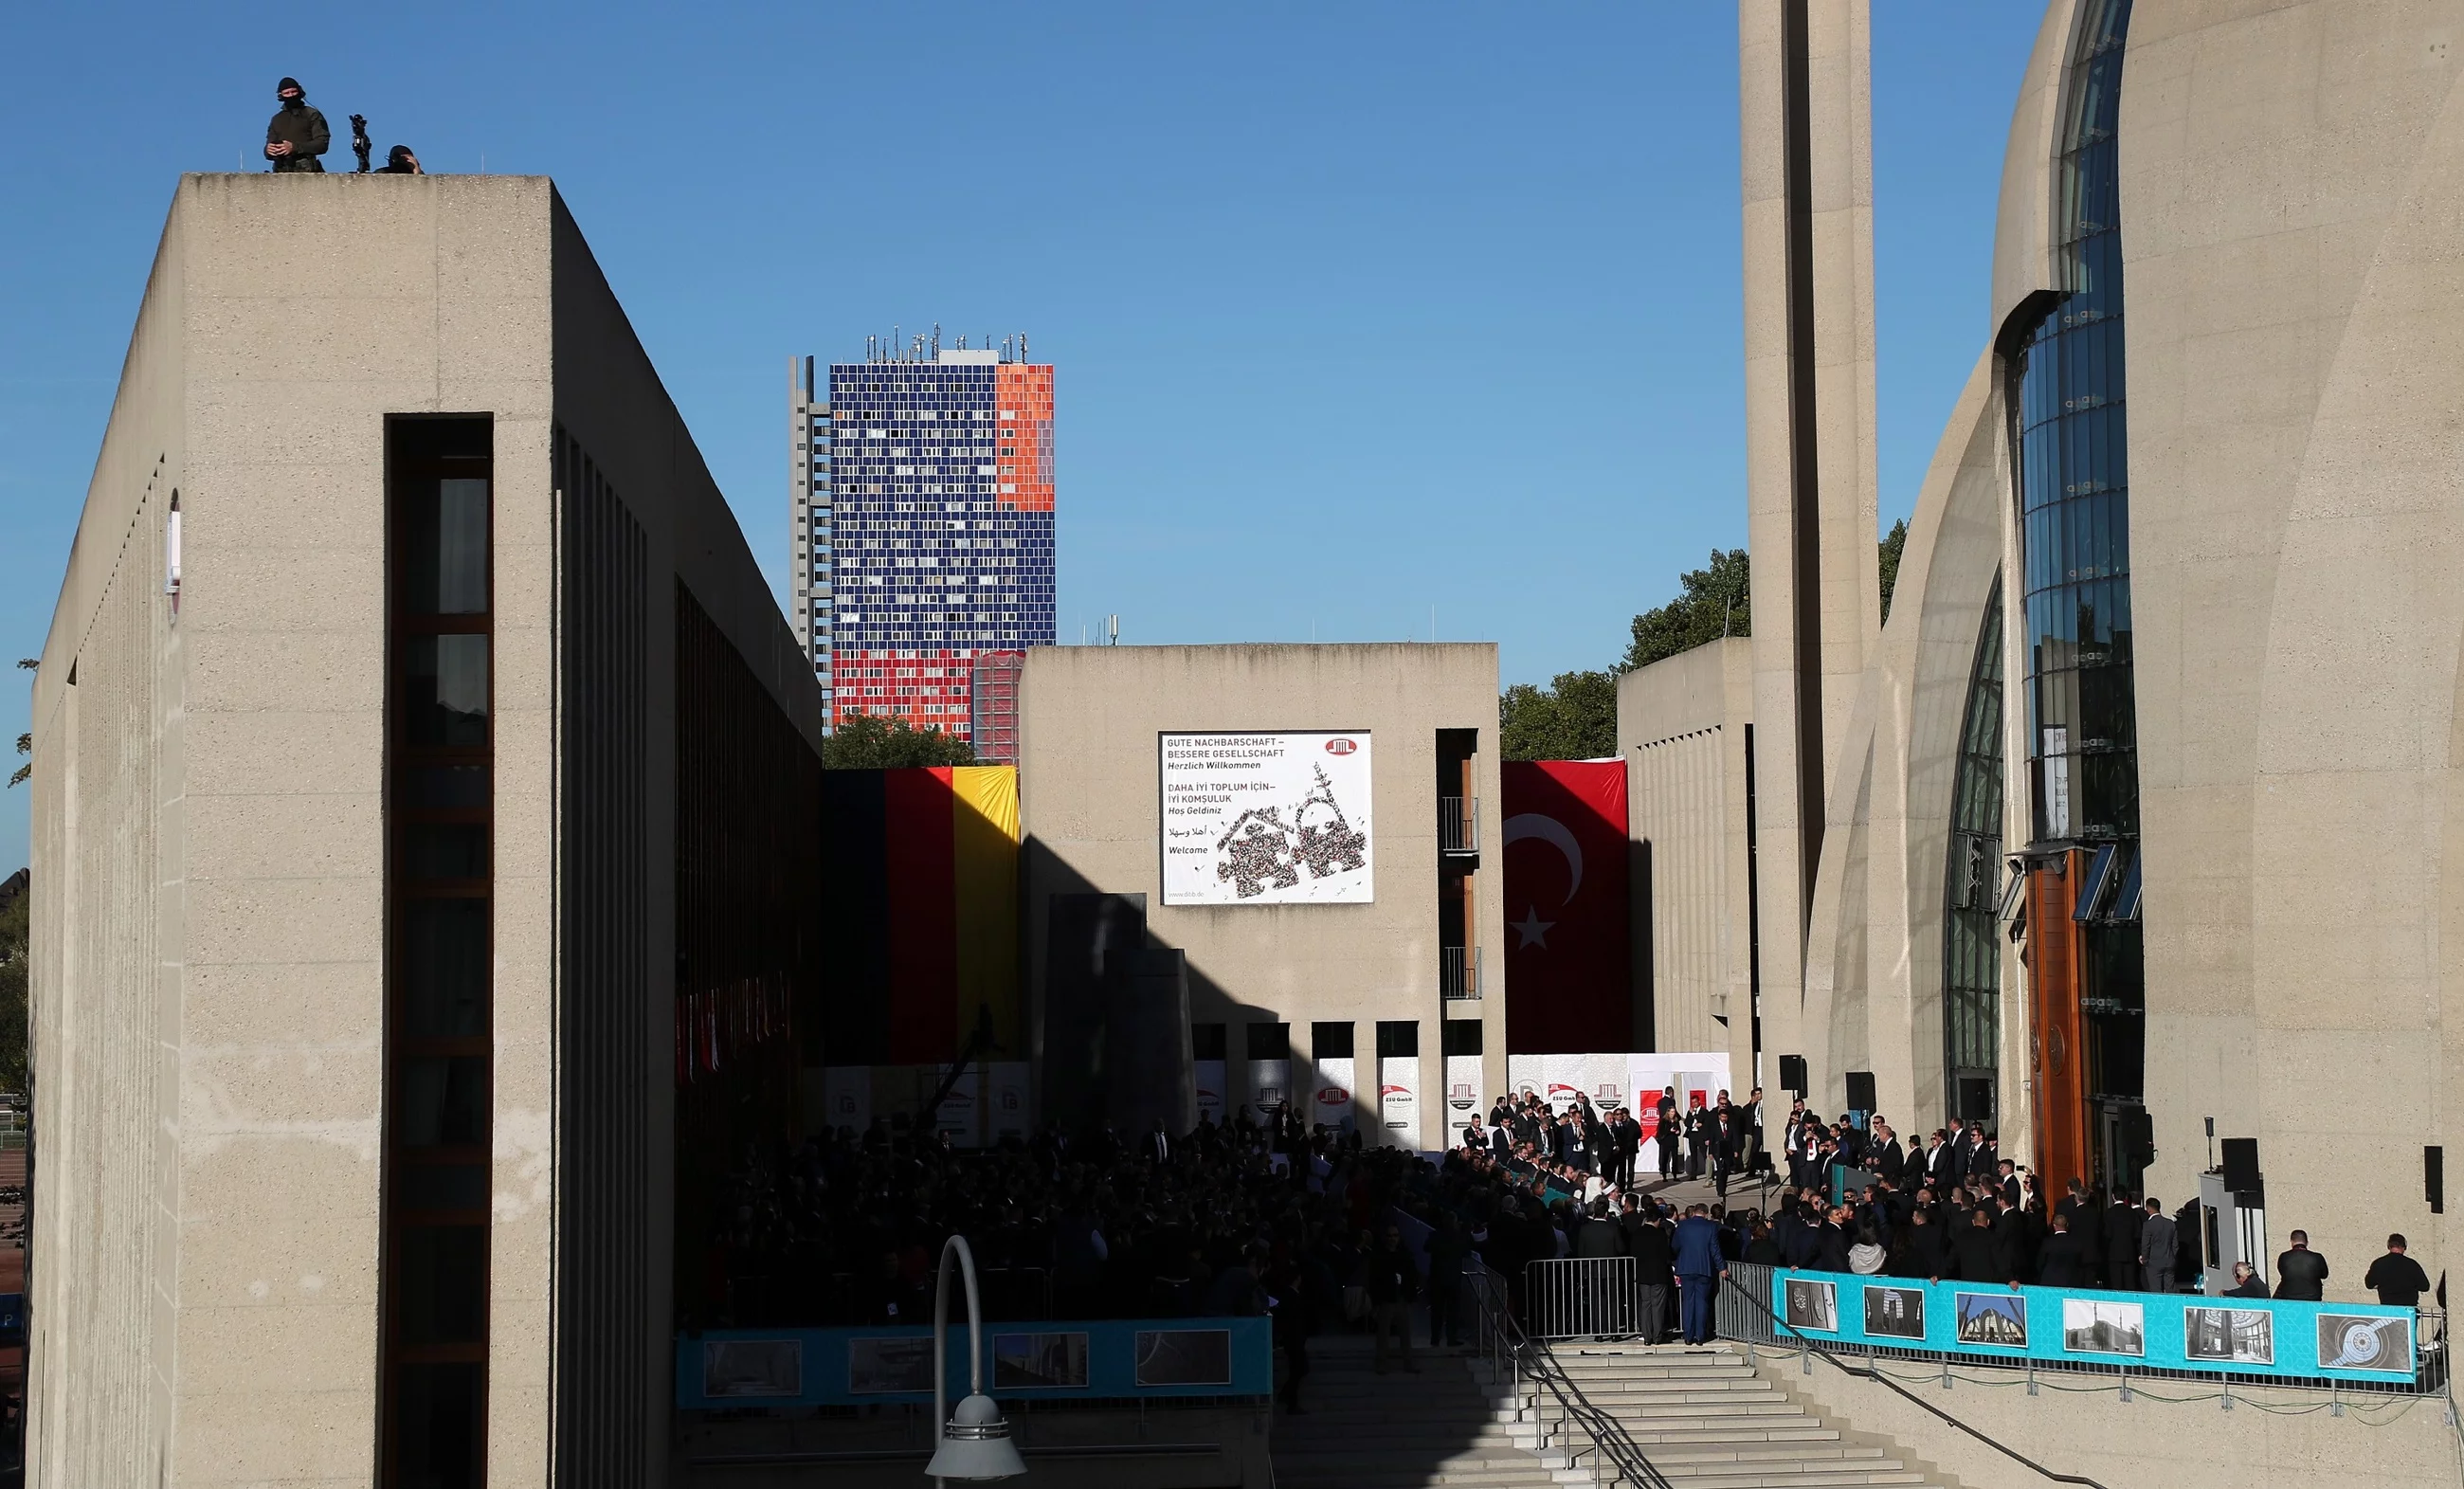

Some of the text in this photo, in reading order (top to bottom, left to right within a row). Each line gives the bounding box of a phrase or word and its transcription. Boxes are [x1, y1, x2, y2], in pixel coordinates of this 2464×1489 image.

[1168, 738, 1192, 748] GUTE
[1194, 737, 1277, 748] NACHBARSCHAFT
[1168, 749, 1285, 759] BESSERE GESELLSCHAFT
[1168, 761, 1261, 771] Herzlich Willkommen
[1168, 784, 1194, 792] DAHA
[1196, 782, 1208, 792] İYİ
[1210, 783, 1248, 792] TOPLUM
[1168, 793, 1232, 805] İYİ KOMŞULUK
[1168, 807, 1223, 816] Hoş Geldiniz
[1191, 825, 1207, 835] أهلا
[1169, 846, 1208, 855] Welcome
